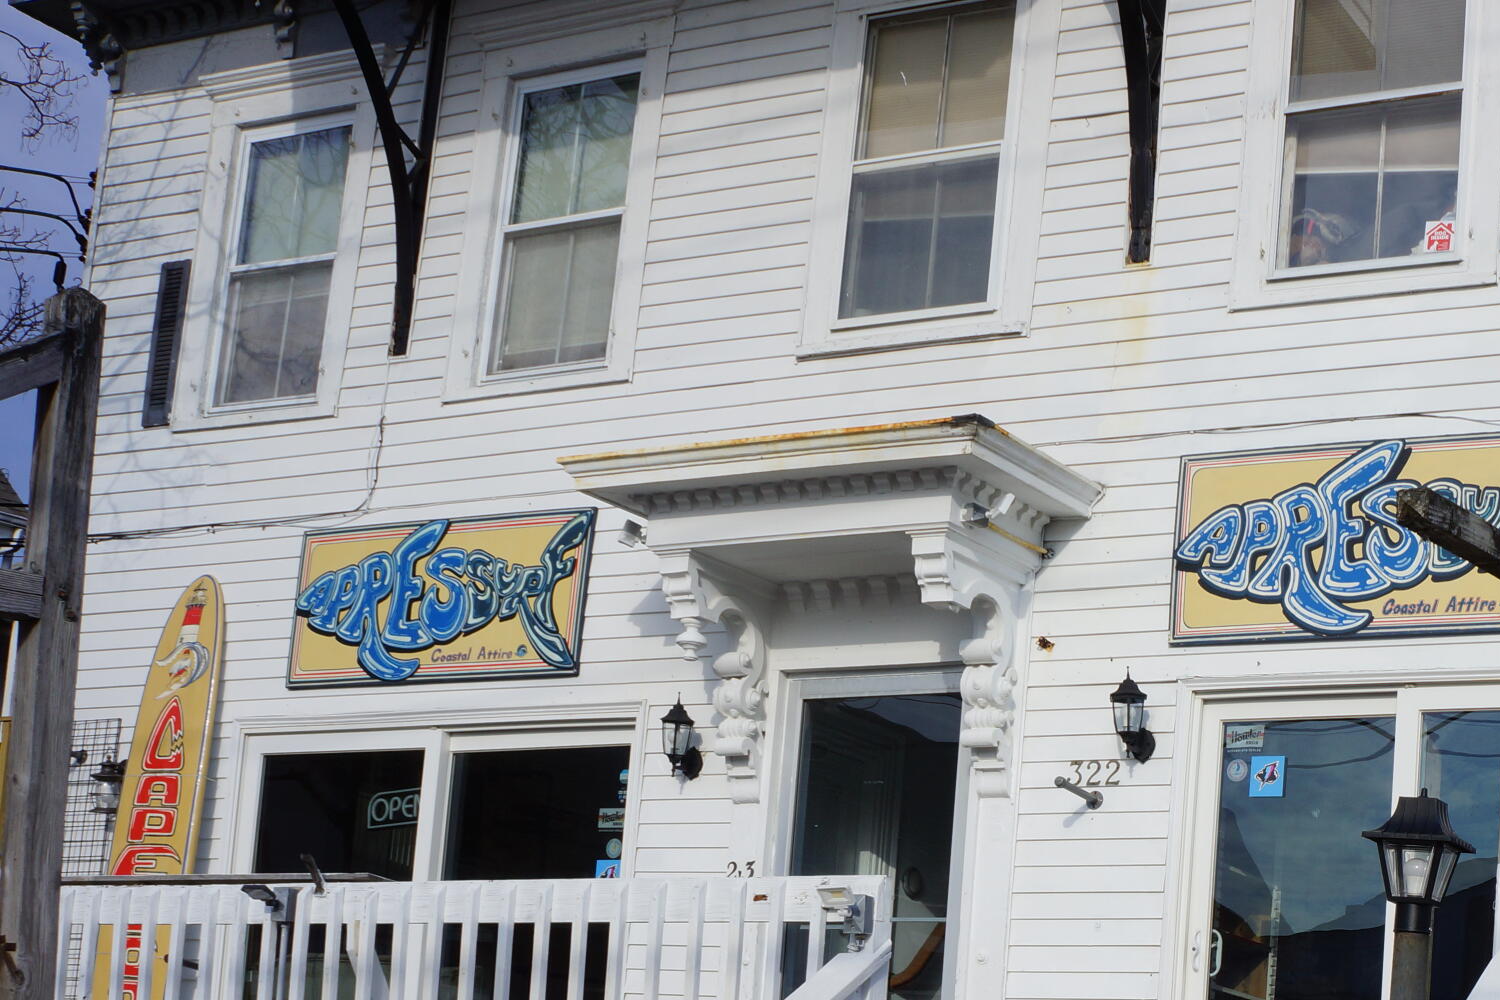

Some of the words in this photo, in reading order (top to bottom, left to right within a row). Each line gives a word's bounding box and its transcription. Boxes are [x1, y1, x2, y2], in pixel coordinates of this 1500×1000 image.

[1382, 598, 1439, 616] Coastal
[1445, 596, 1497, 613] Attire
[430, 646, 473, 663] Coastal
[477, 645, 513, 660] Attire
[1066, 759, 1121, 786] 322
